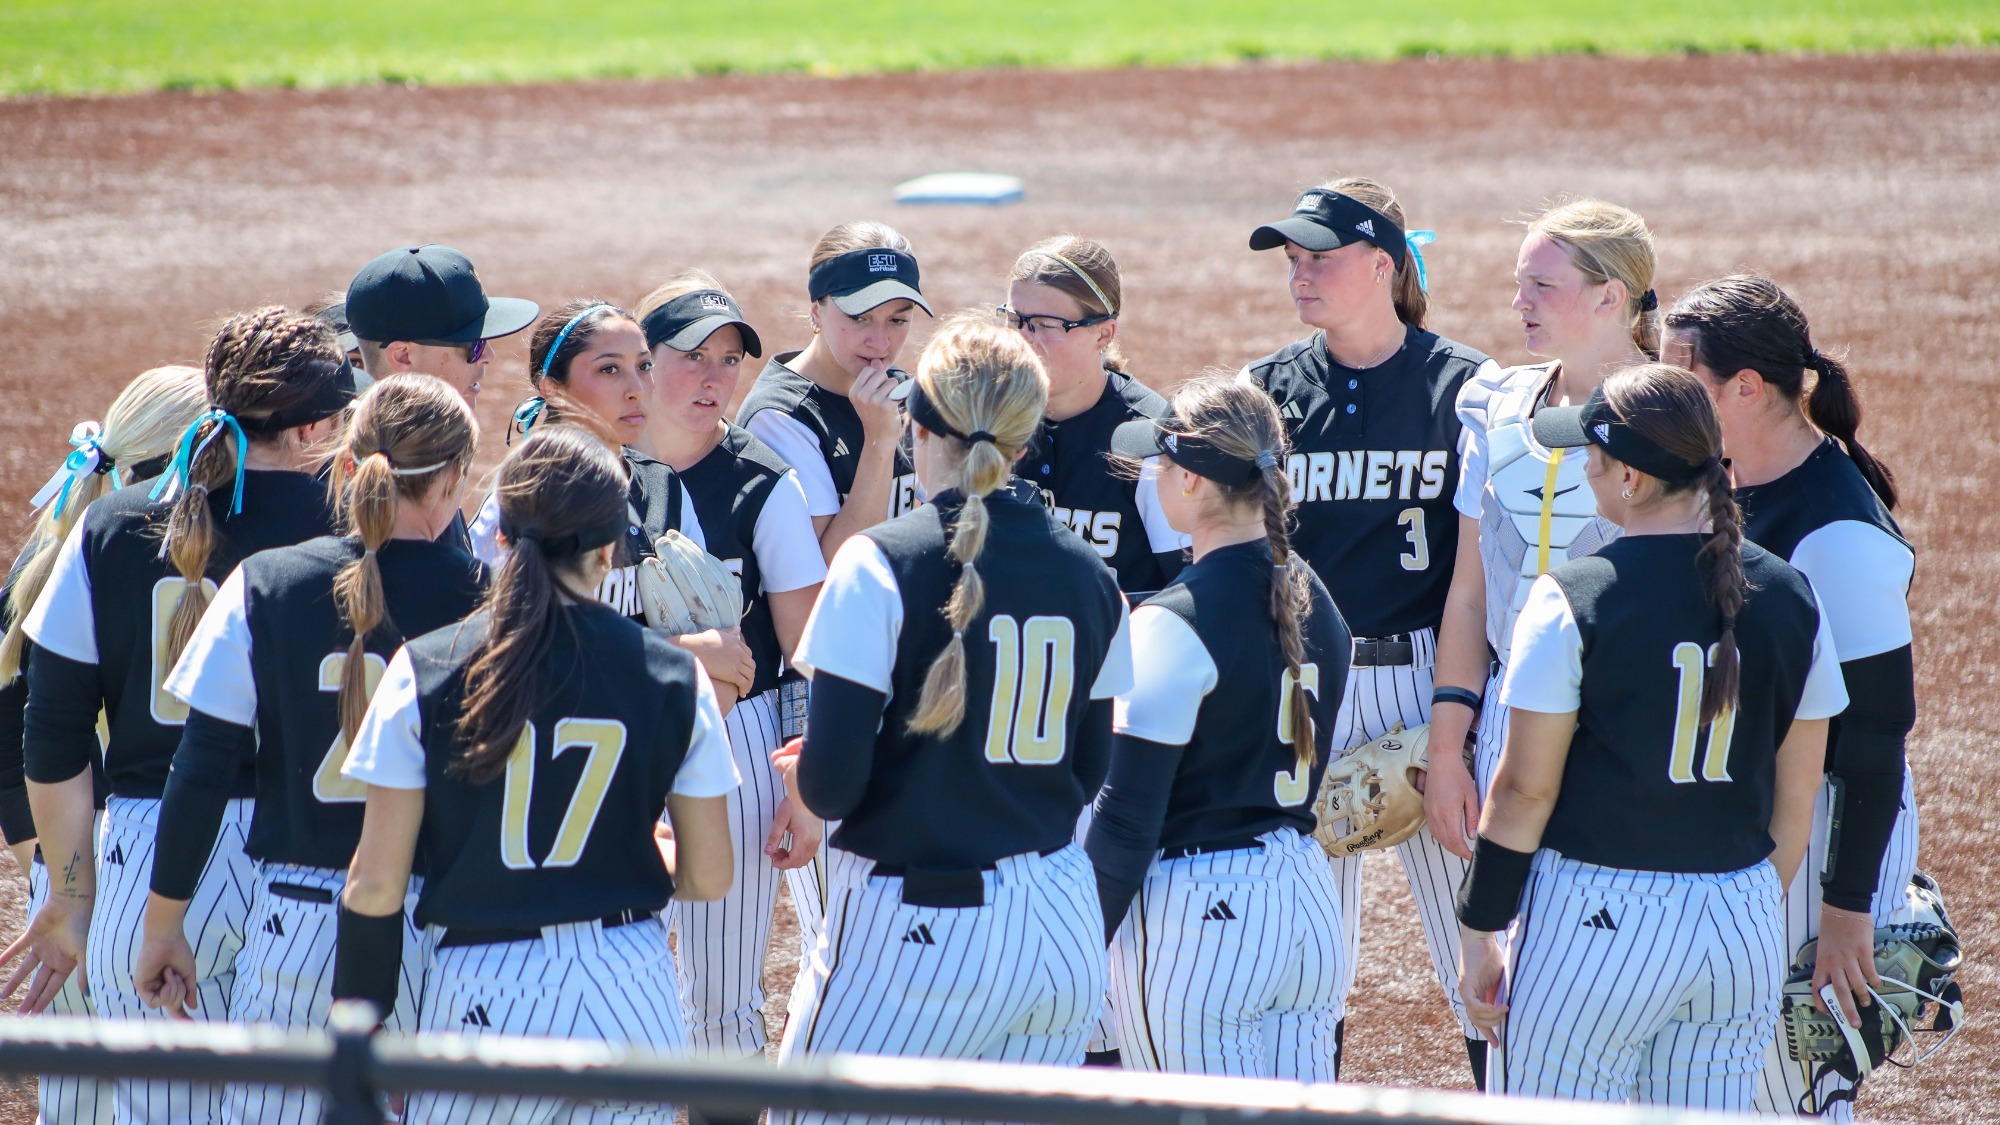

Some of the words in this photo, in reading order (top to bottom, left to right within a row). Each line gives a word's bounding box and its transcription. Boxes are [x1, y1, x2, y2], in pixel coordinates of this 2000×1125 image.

[868, 254, 897, 267] ESU
[700, 295, 728, 306] ESU
[1284, 450, 1448, 502] ORNETS
[1397, 507, 1430, 571] 3
[984, 614, 1075, 765] 10
[1668, 641, 1741, 784] 11
[1274, 662, 1319, 807] 5
[500, 716, 627, 870] 17
[1347, 828, 1384, 853] Rawlings
